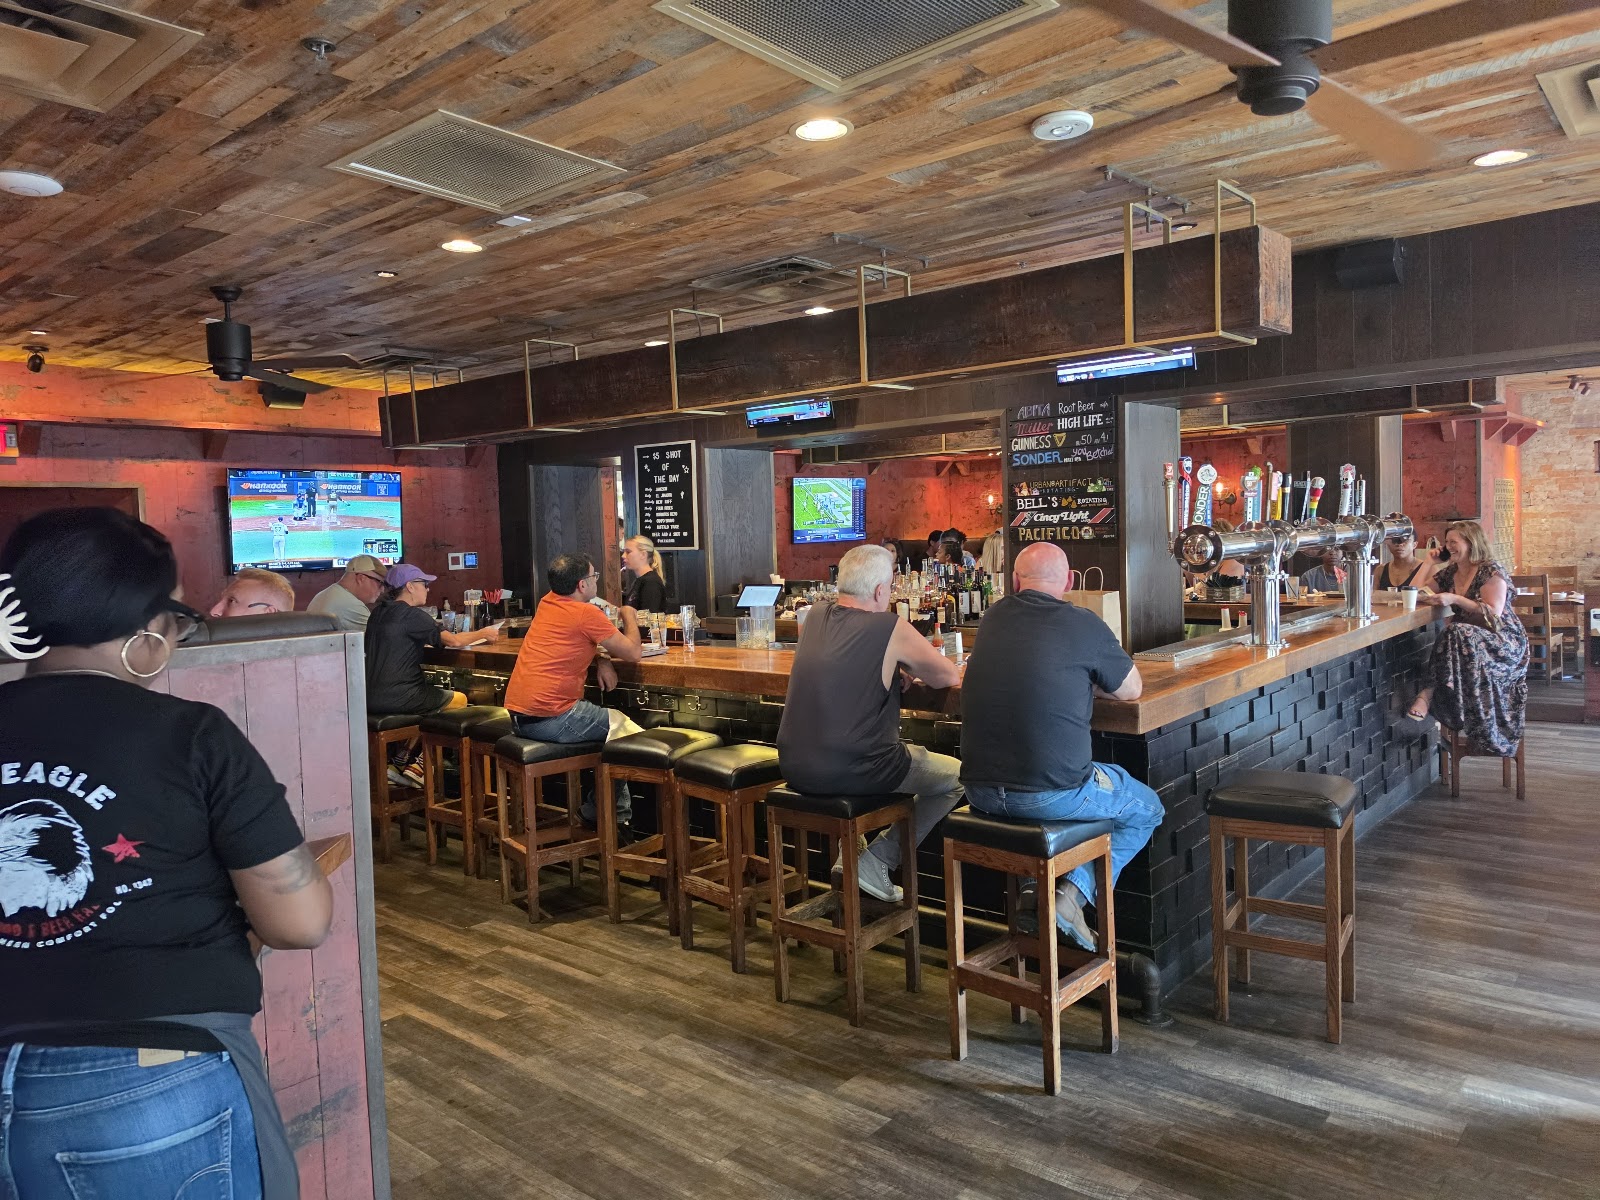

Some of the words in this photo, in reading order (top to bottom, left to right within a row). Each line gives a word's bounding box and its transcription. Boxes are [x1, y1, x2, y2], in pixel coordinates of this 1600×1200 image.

[1058, 403, 1075, 415] Root
[1078, 401, 1095, 413] Beer
[1015, 422, 1053, 435] Miller
[1057, 416, 1080, 430] HIGH
[1083, 414, 1104, 427] LIFE
[1011, 435, 1052, 452] GUINNESS
[665, 450, 682, 459] SHOT
[1012, 451, 1064, 467] SONDER
[661, 462, 670, 471] OF
[653, 475, 666, 483] THE
[668, 474, 680, 483] DAY
[1016, 496, 1058, 510] BELL'S
[1194, 486, 1210, 523] ONDER
[1033, 512, 1060, 523] Cincy
[1061, 510, 1090, 523] Light
[1018, 526, 1080, 541] PACIFICO
[1, 761, 117, 810] EAGLE
[36, 921, 98, 948] COMFORT
